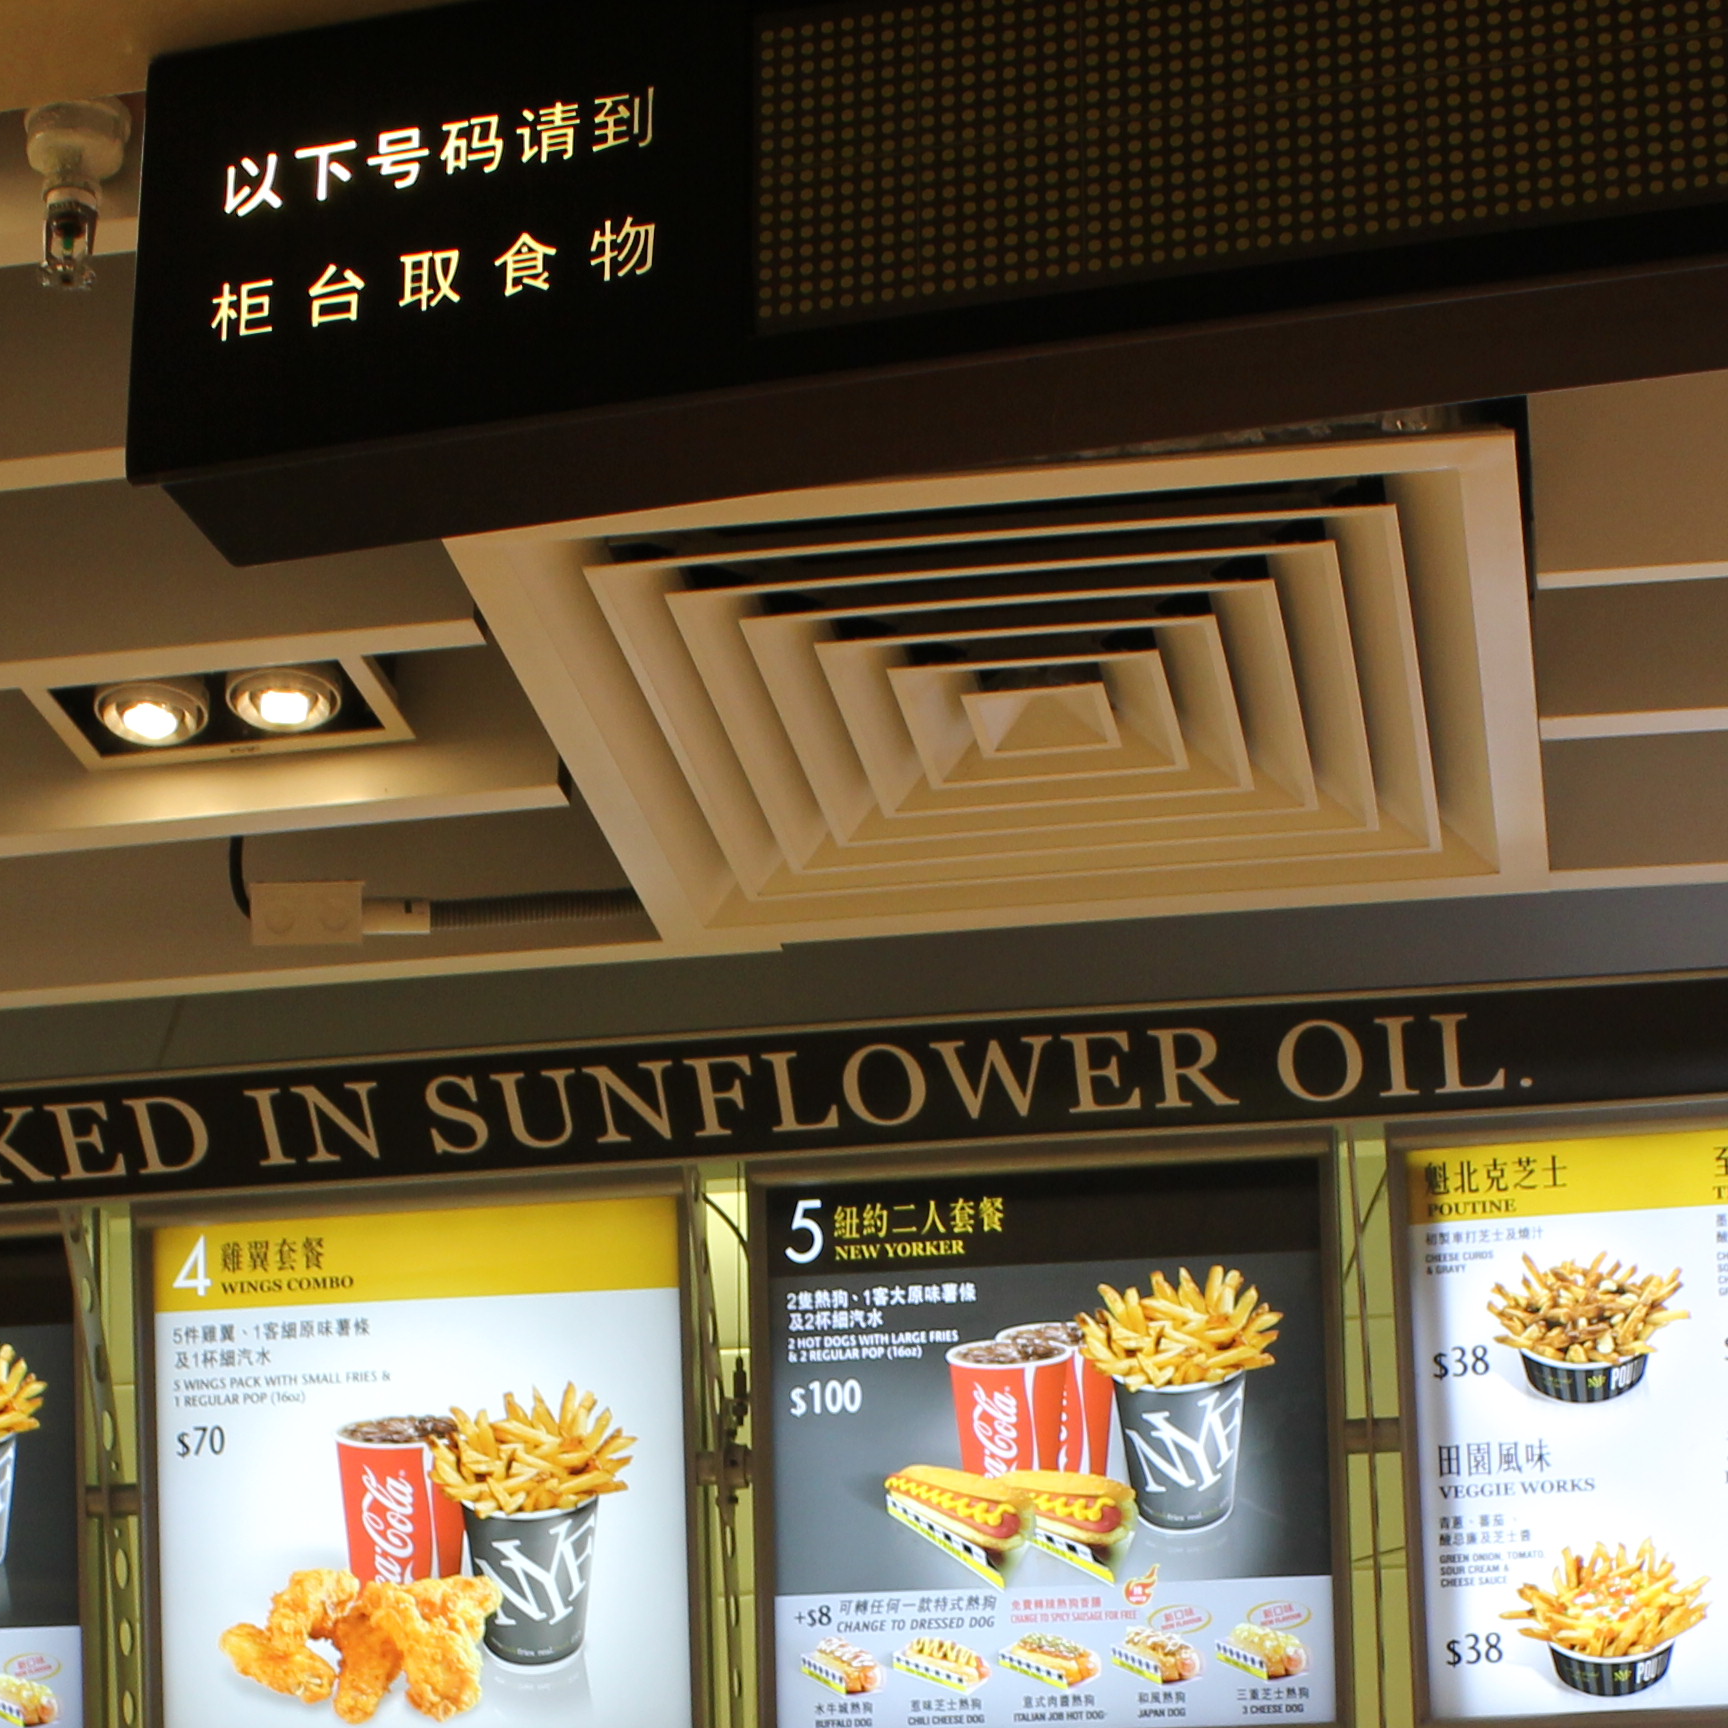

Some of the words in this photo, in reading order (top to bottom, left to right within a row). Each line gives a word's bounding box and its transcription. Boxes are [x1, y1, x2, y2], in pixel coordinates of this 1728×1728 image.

[224, 86, 654, 216] 以下号码请到
[211, 216, 655, 342] 柜台取食物
[243, 1080, 384, 1170] IN
[424, 1027, 1242, 1158] SUNFLOWER
[1275, 1013, 1536, 1102] OIL.
[1425, 1154, 1568, 1196] 魁北克芝士
[833, 1196, 1005, 1240] 紐約二人套餐
[1428, 1198, 1517, 1218] POUTINE
[785, 1199, 823, 1264] 5
[173, 1235, 212, 1297] 4
[221, 1236, 325, 1274] 雞翼套餐
[834, 1244, 880, 1261] NEW
[884, 1239, 966, 1257] YORKER
[221, 1279, 283, 1295] WINGS
[287, 1275, 354, 1292] COMBO
[788, 1338, 795, 1350] 2
[797, 1336, 821, 1349] HOT
[823, 1334, 857, 1348] DOGS
[859, 1333, 889, 1346] WITH
[891, 1331, 927, 1344] LARGE
[929, 1330, 959, 1343] FRIES
[788, 1350, 798, 1363] &
[800, 1350, 808, 1362] 2
[809, 1347, 860, 1362] REGULAR
[862, 1346, 885, 1359] POP
[175, 1347, 271, 1370] 及1杯細汽水
[1432, 1345, 1491, 1380] $38
[174, 1380, 181, 1392] 5
[183, 1377, 226, 1391] WINGS
[229, 1376, 261, 1389] PACK
[264, 1374, 298, 1387] WITH
[302, 1372, 342, 1385] SMALL
[345, 1371, 377, 1384] FRIES
[790, 1378, 862, 1417] $100
[184, 1393, 239, 1407] REGULAR
[242, 1392, 268, 1405] POP
[176, 1425, 225, 1458] $70
[1126, 1387, 1245, 1494] NYF
[1438, 1438, 1552, 1478] 田園風味
[1439, 1482, 1516, 1500] VEGGIE
[1520, 1477, 1595, 1495] WORKS
[473, 1512, 597, 1626] NYF
[794, 1604, 832, 1628] +$8
[836, 1619, 886, 1634] CHANGE
[891, 1618, 906, 1631] TO
[909, 1617, 965, 1631] DRESSED
[969, 1616, 995, 1629] DOG
[1445, 1632, 1503, 1668] $38
